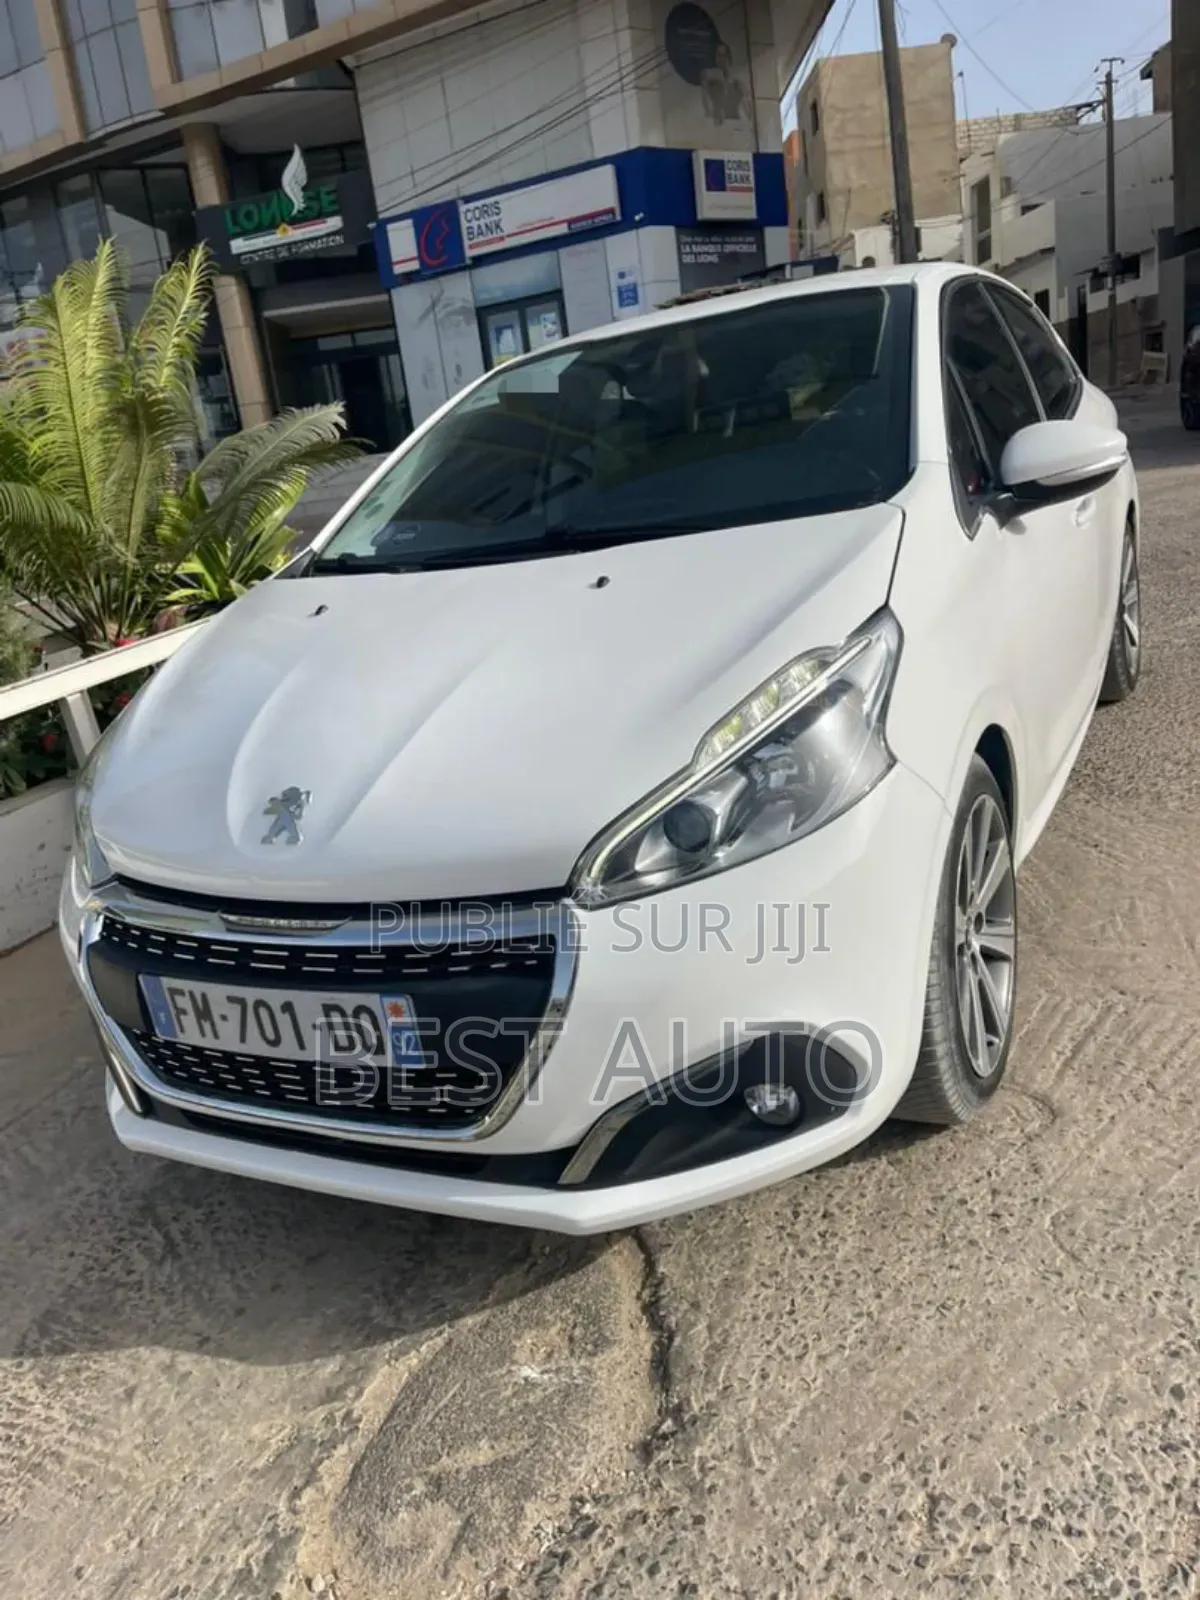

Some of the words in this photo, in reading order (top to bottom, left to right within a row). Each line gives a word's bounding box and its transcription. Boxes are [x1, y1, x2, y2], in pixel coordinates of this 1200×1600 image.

[728, 173, 751, 184] BANK
[463, 200, 502, 224] CORIS
[466, 219, 505, 241] BANK
